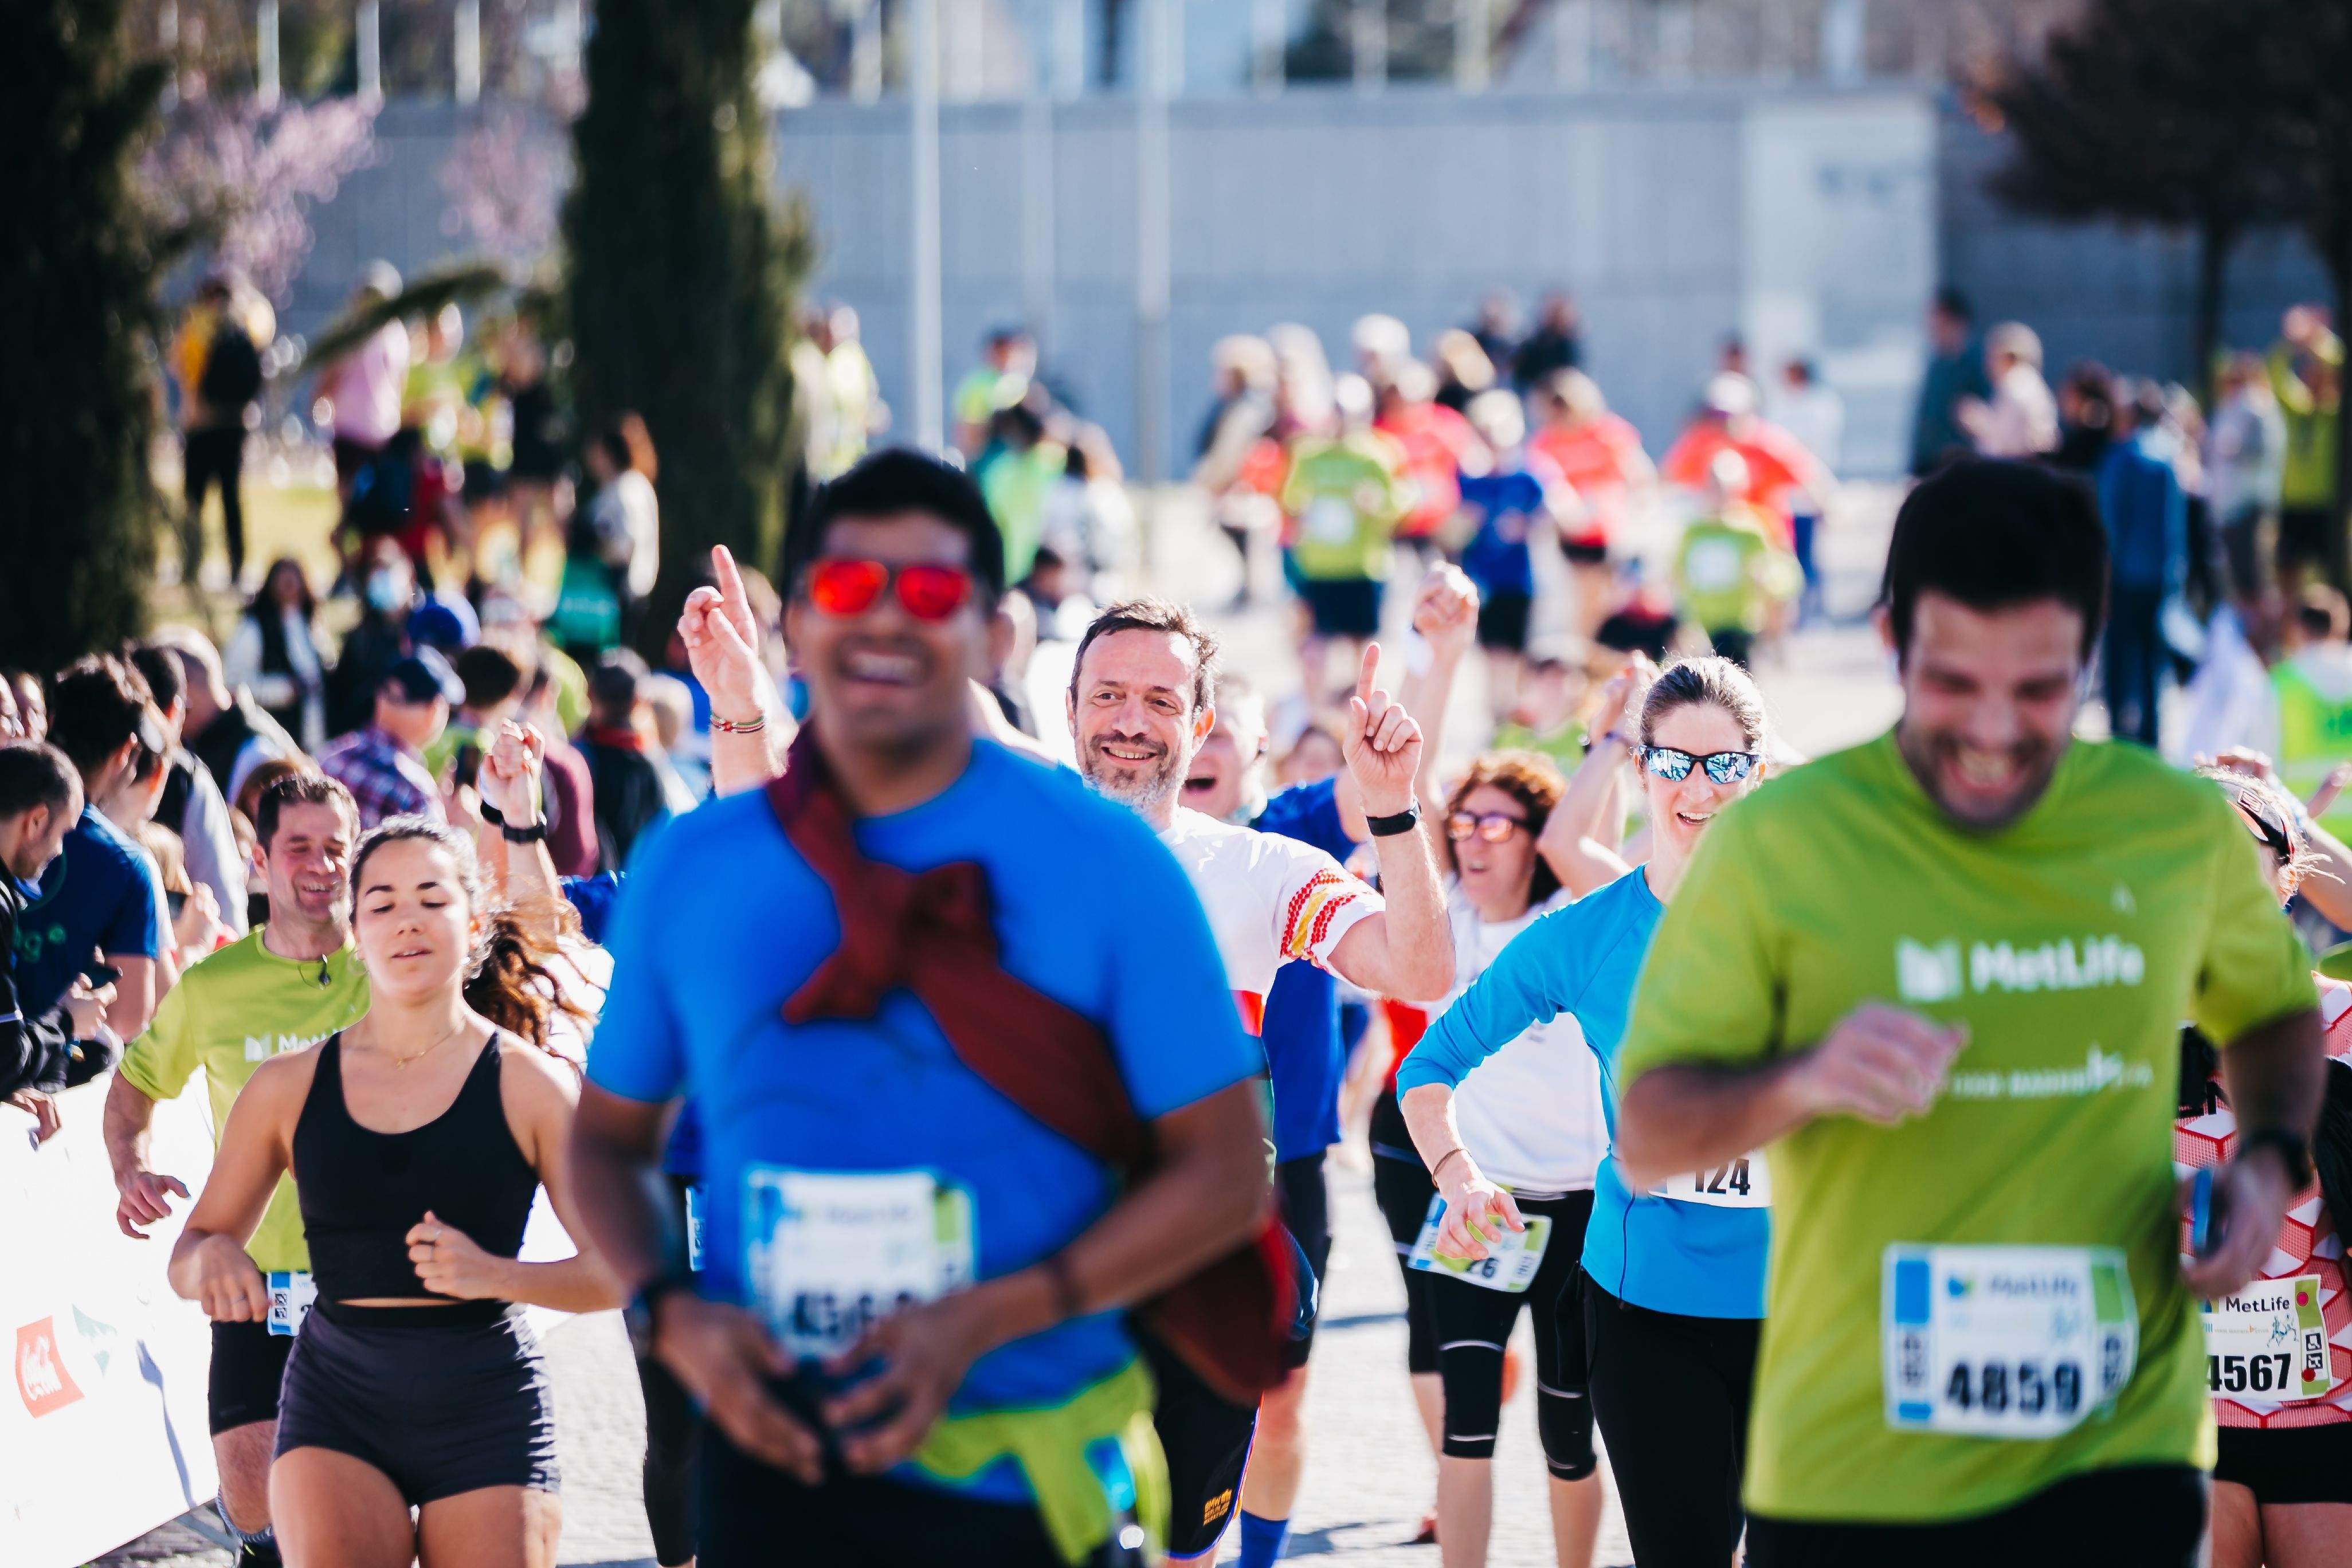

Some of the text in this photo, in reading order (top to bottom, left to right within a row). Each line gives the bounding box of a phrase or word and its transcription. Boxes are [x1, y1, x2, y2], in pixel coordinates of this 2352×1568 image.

[1969, 934, 2144, 993] MetLife
[2226, 1296, 2290, 1312] MetLife
[1948, 1361, 2081, 1414] 4859
[2207, 1353, 2291, 1391] 4567
